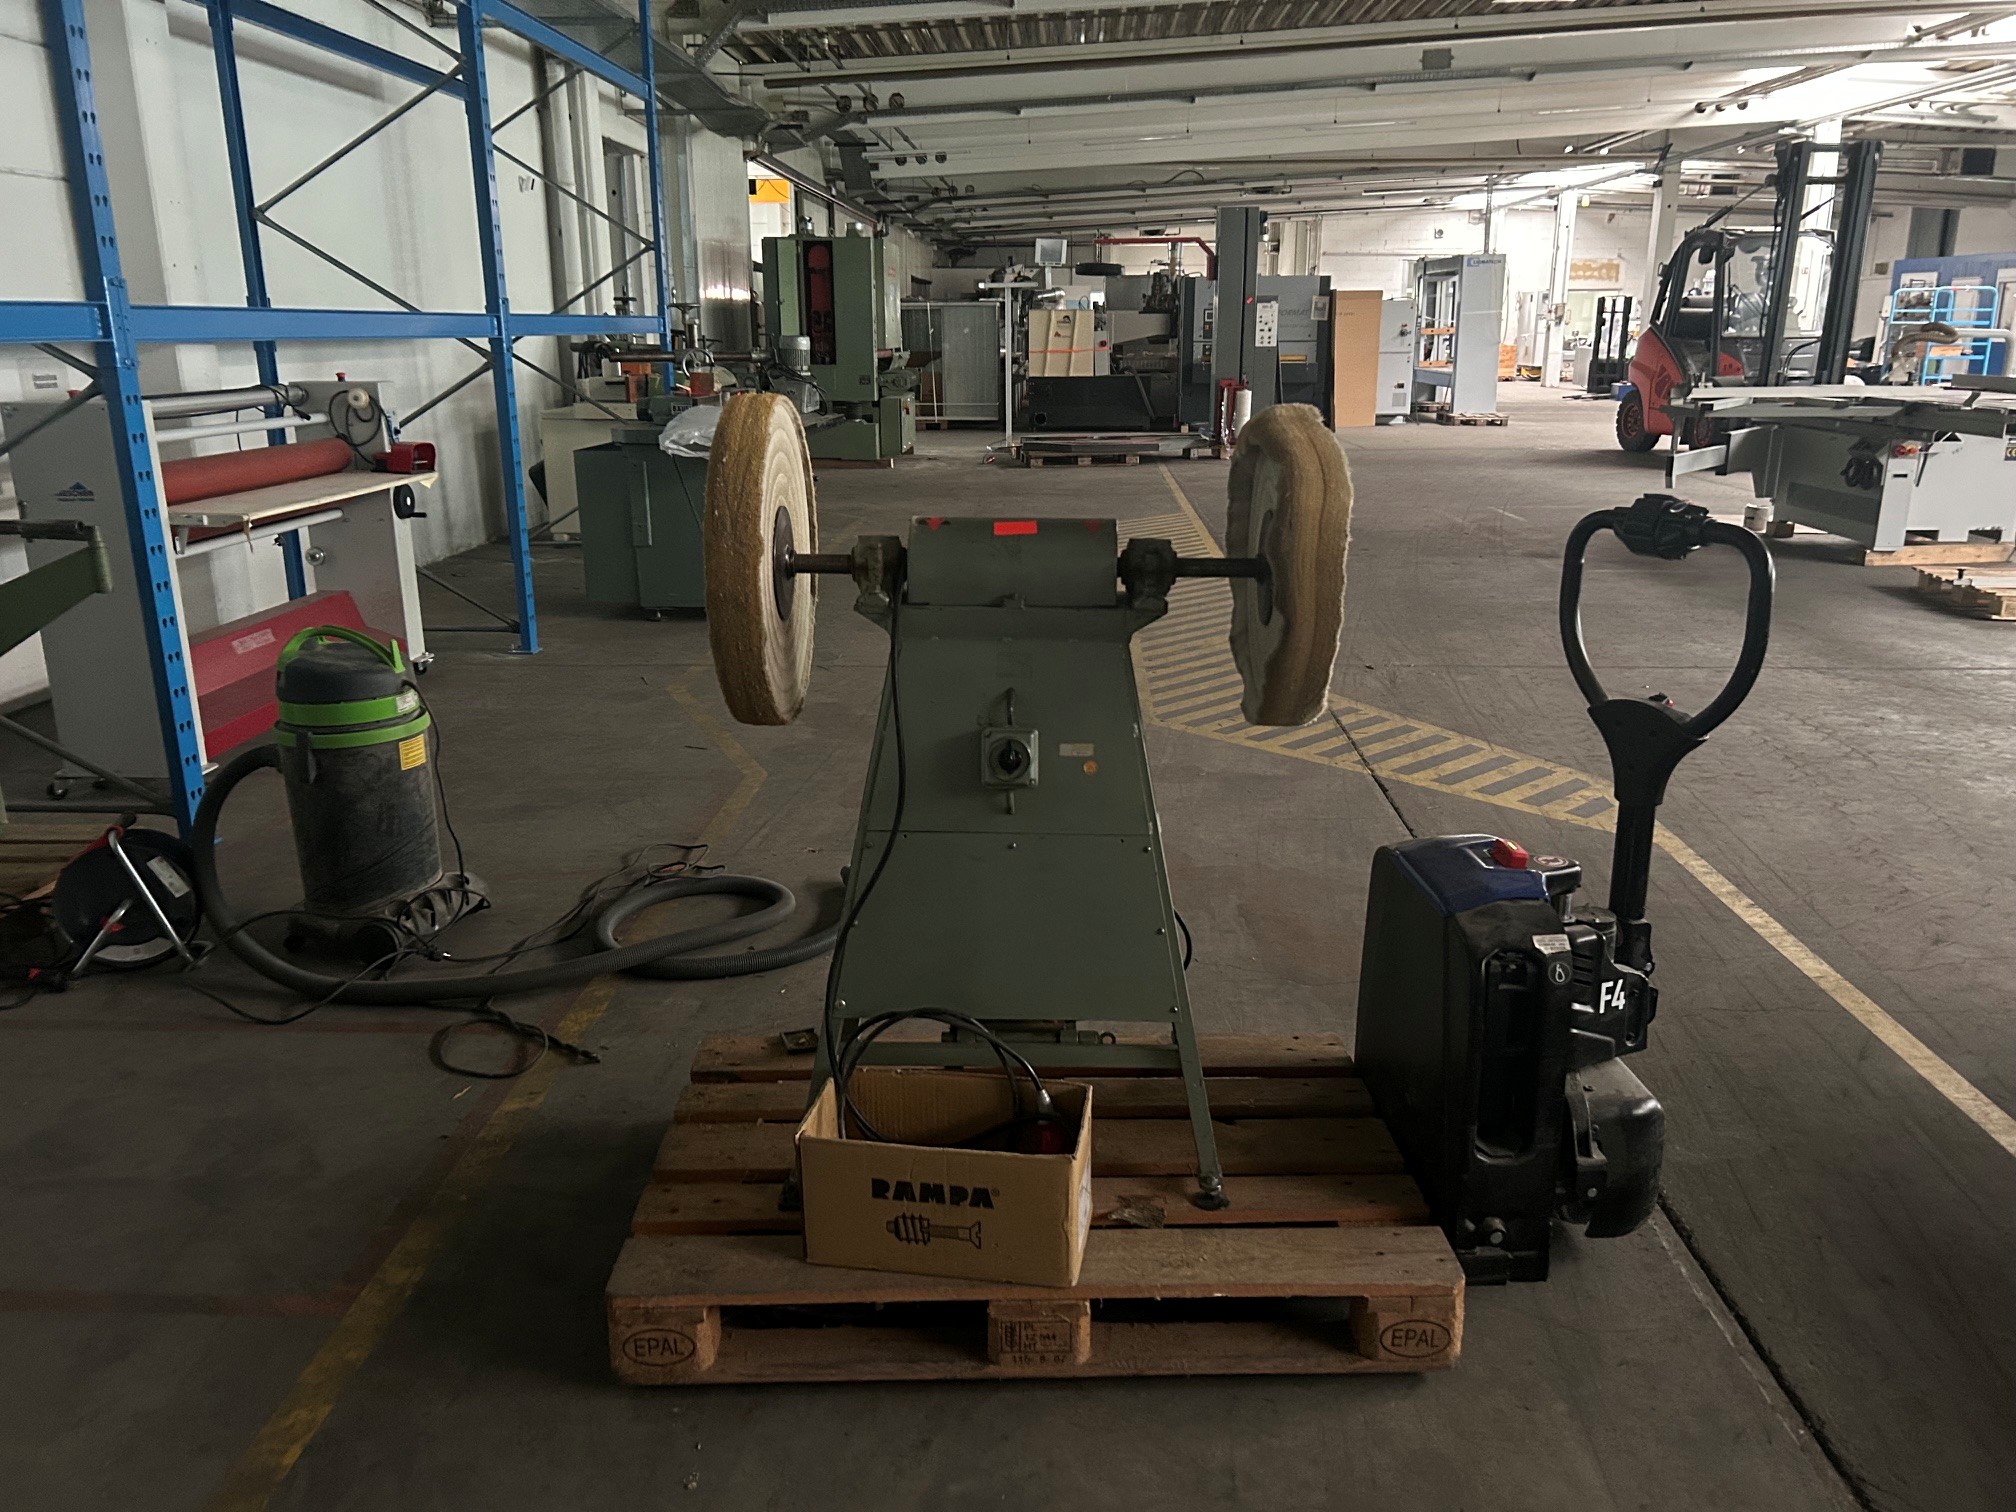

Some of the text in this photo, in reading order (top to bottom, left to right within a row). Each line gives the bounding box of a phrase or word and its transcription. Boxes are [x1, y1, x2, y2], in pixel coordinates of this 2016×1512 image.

[1599, 979, 1626, 1014] F4
[634, 1337, 686, 1357] EPAL
[1391, 1328, 1440, 1348] EPAL
